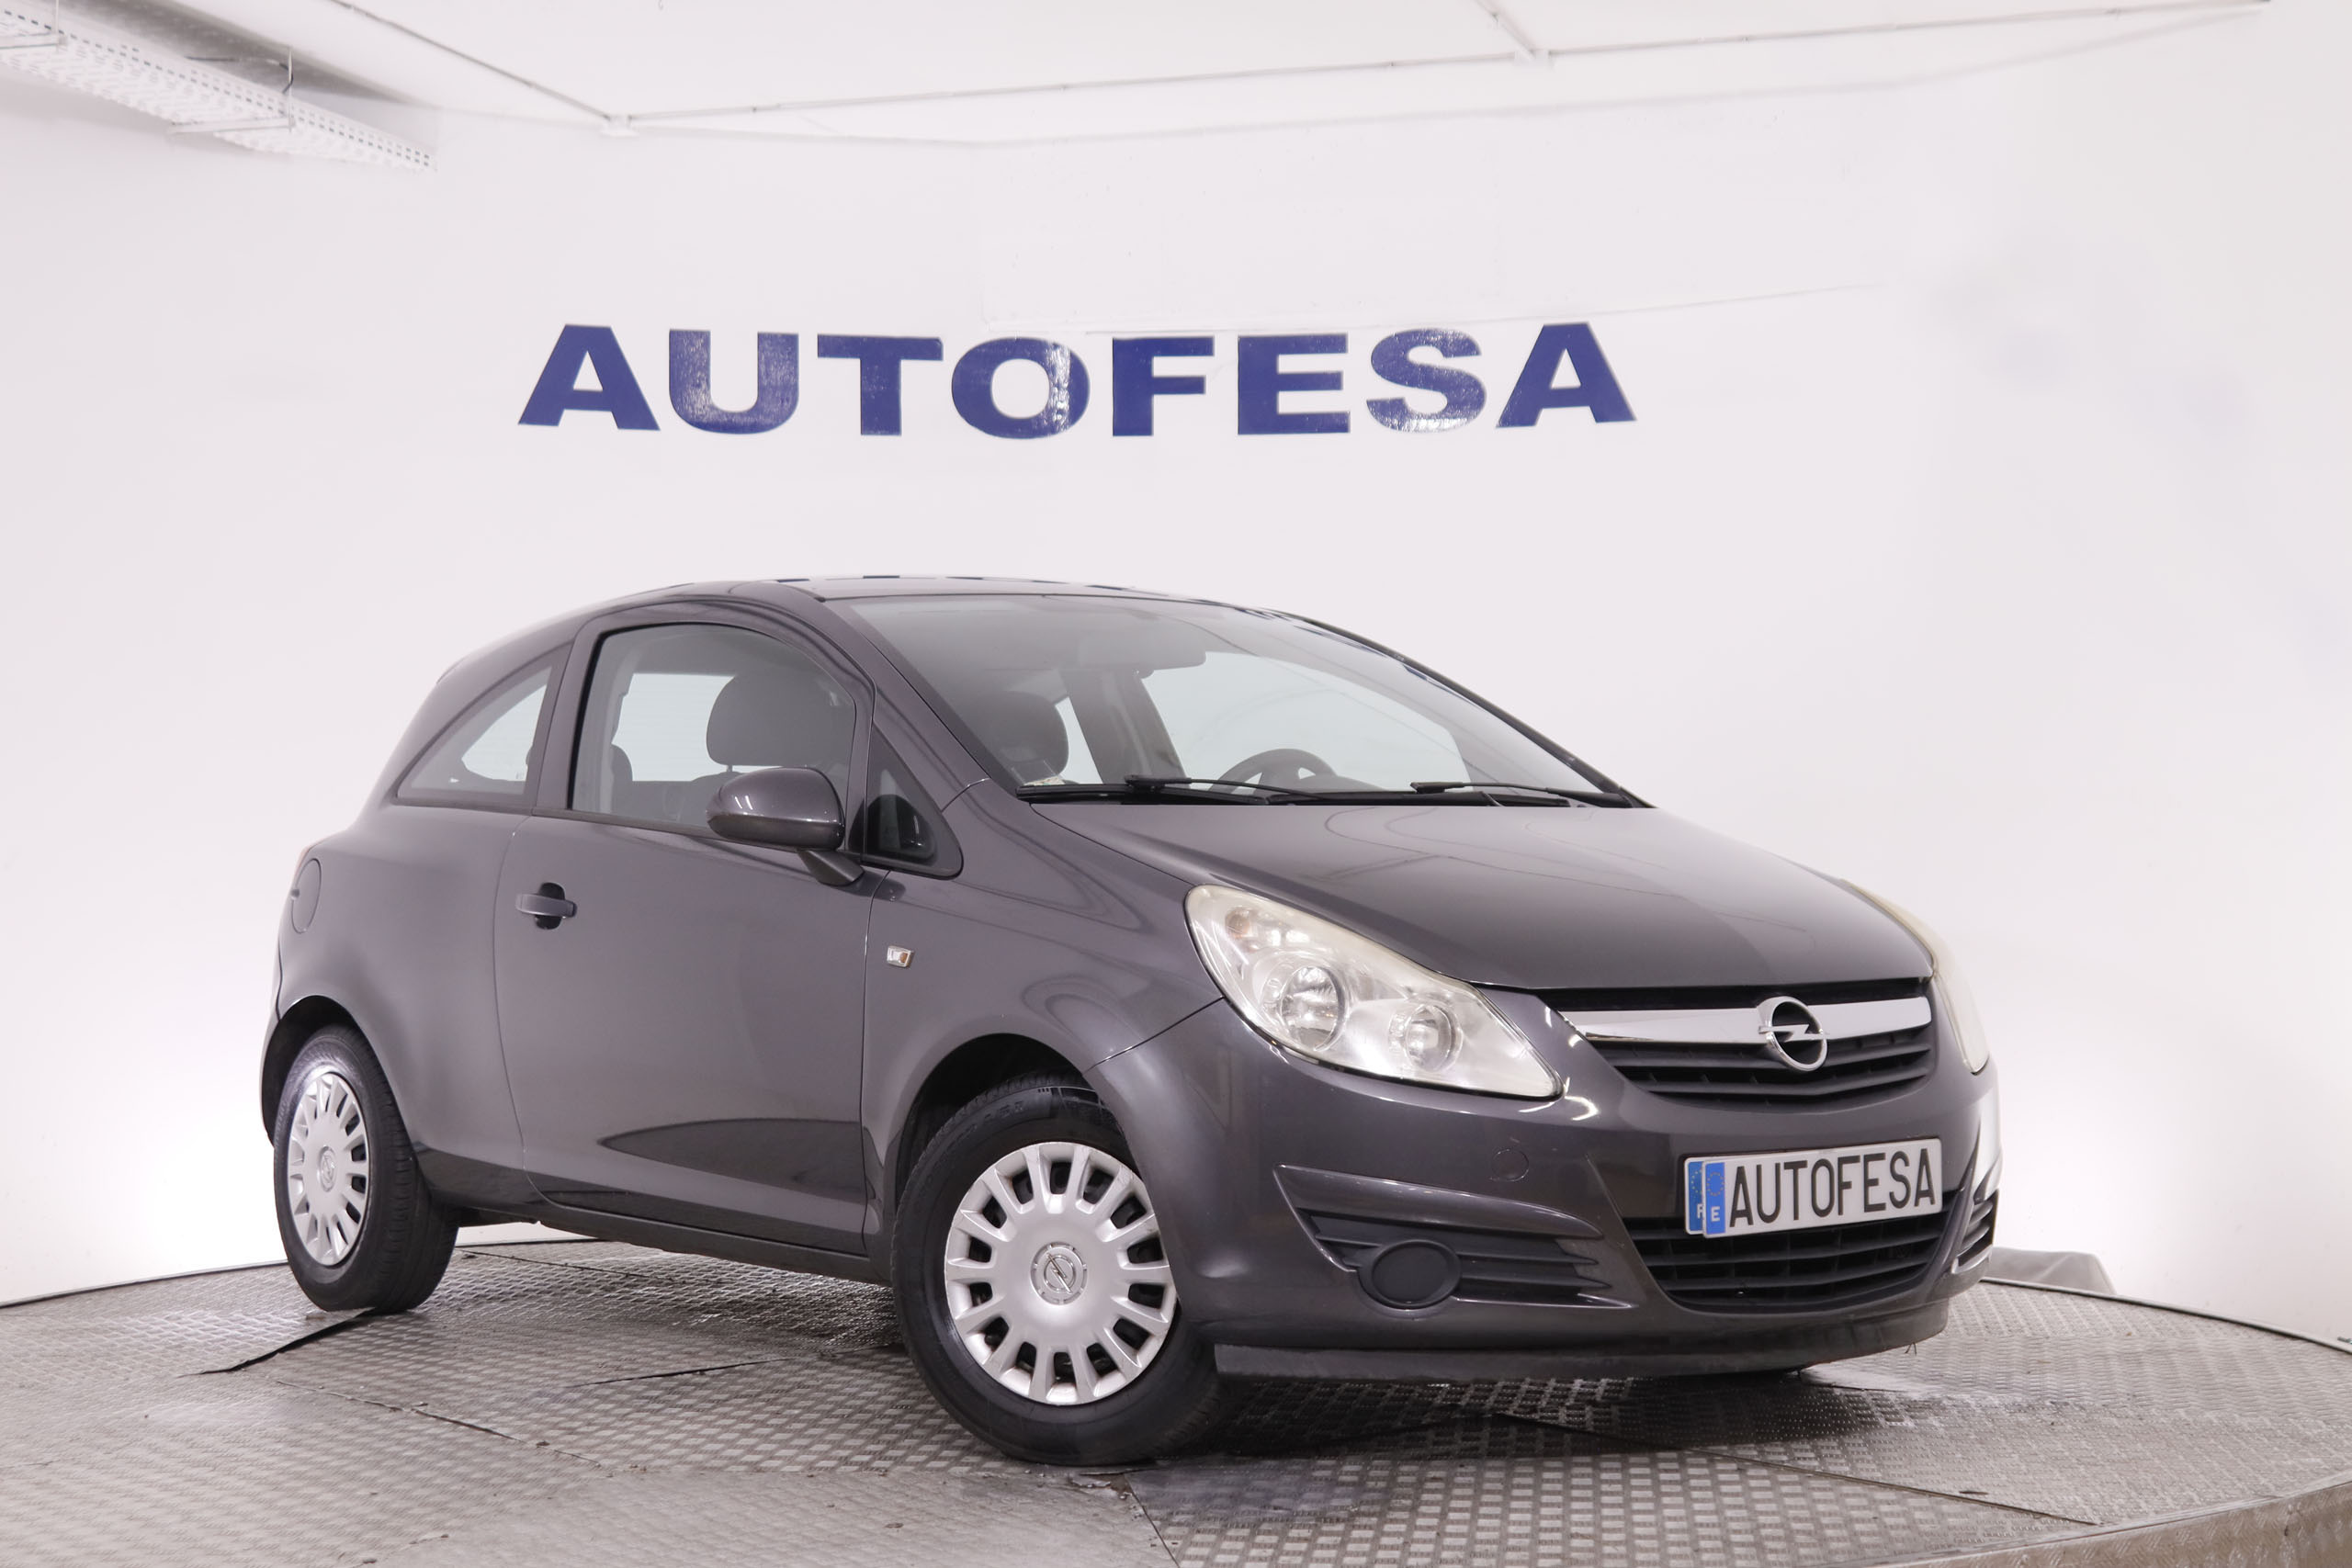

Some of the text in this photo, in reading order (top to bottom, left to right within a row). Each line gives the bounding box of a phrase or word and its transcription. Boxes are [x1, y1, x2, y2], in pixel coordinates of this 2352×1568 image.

[518, 322, 1636, 439] AUTOFESA
[1711, 1205, 1721, 1222] E
[1729, 1148, 1936, 1228] AUTOFESA
